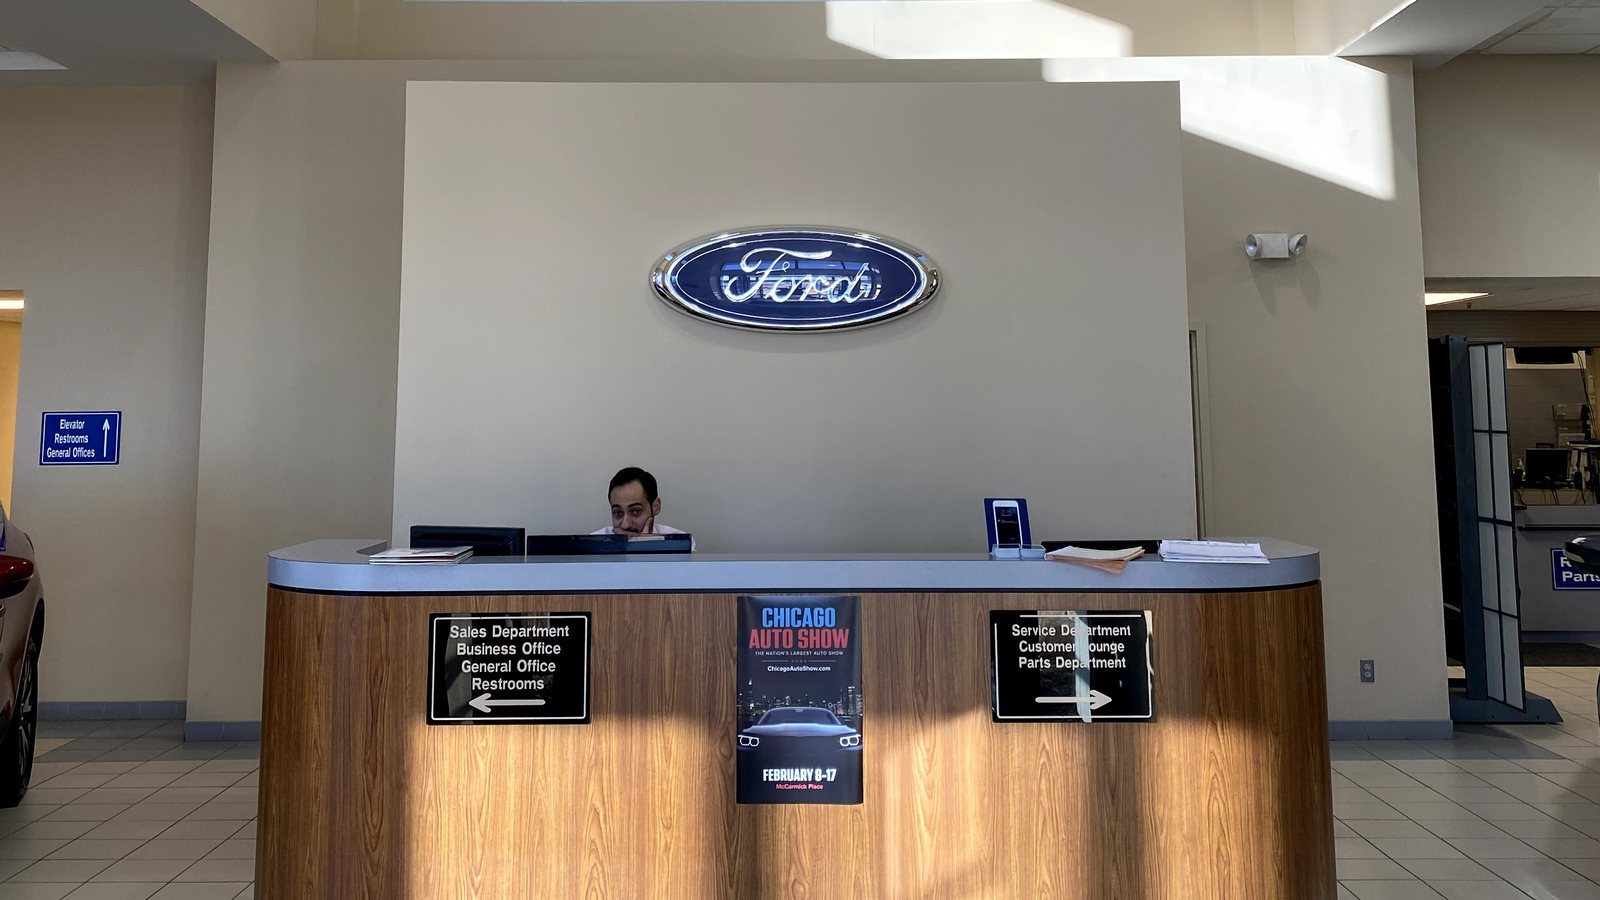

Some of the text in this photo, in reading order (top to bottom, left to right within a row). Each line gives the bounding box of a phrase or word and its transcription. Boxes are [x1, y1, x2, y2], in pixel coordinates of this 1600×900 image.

[724, 247, 869, 303] Ford
[60, 418, 85, 430] Elevator
[54, 433, 89, 444] Restrooms
[46, 447, 95, 458] General Offices
[762, 607, 836, 628] CHICAGO
[450, 624, 570, 640] Sales Department
[1011, 624, 1131, 637] Service Deartment
[748, 628, 849, 649] AUTO SHOW
[456, 641, 561, 656] Business Office
[1089, 640, 1125, 654] ounge
[461, 659, 556, 673] General Office
[767, 665, 831, 673] ChicagoAutoShow.com
[1018, 656, 1051, 669] Parts
[472, 677, 545, 690] Restrooms
[763, 768, 837, 782] FEBRUARY 8-17
